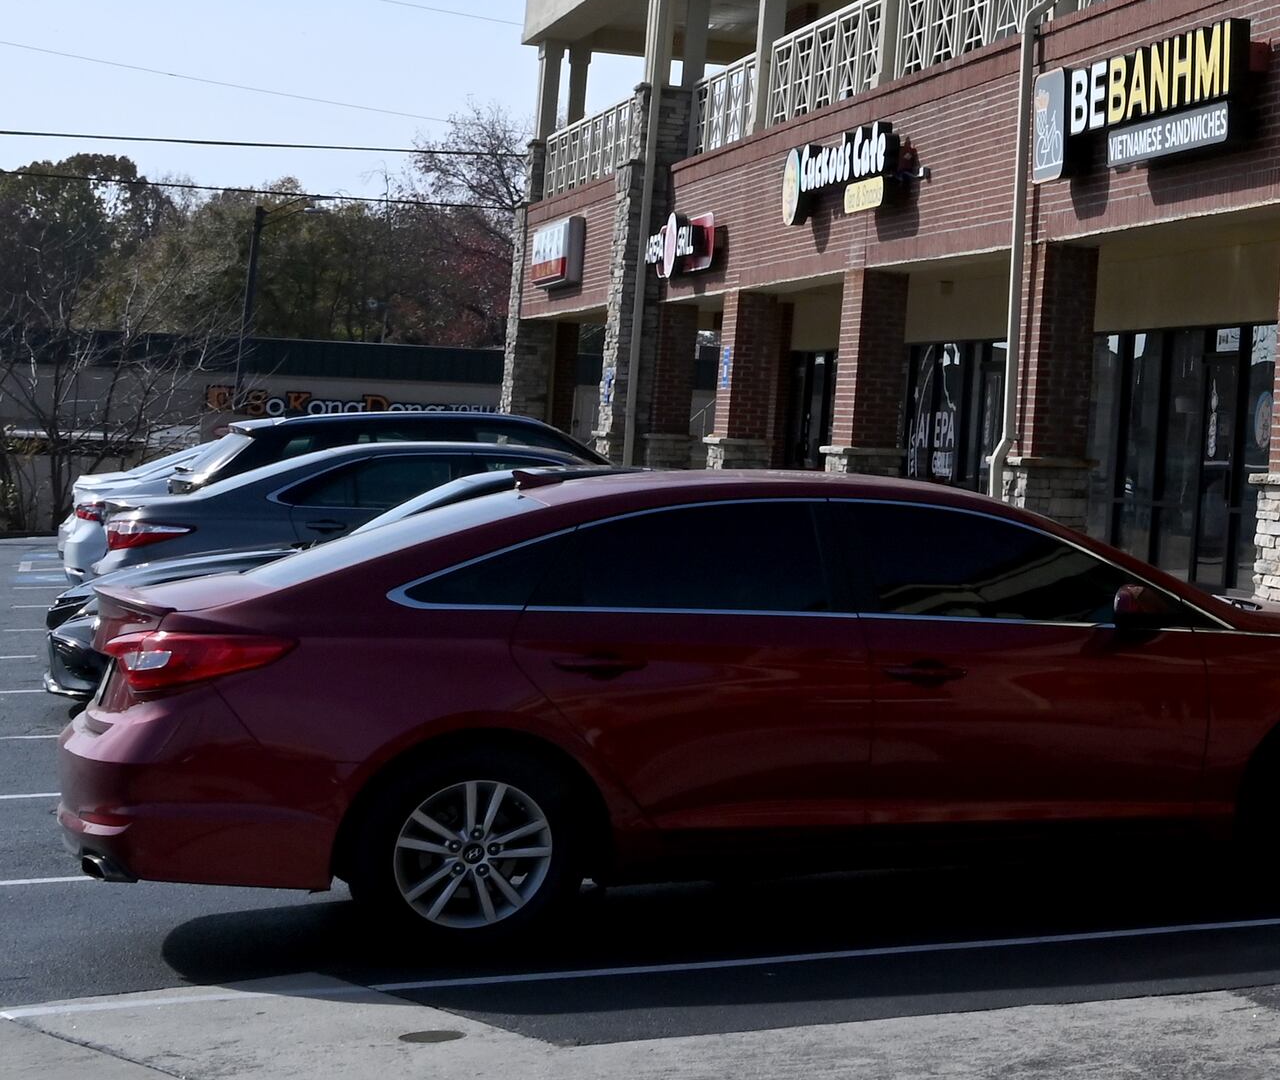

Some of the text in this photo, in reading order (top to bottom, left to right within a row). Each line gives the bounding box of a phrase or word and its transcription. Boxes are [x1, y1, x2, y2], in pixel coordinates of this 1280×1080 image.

[1070, 18, 1232, 136] BEBANHMI
[853, 120, 886, 178] Cafe
[1108, 108, 1227, 162] VIETNAMESE SANDWICHES
[677, 225, 693, 256] GRILL
